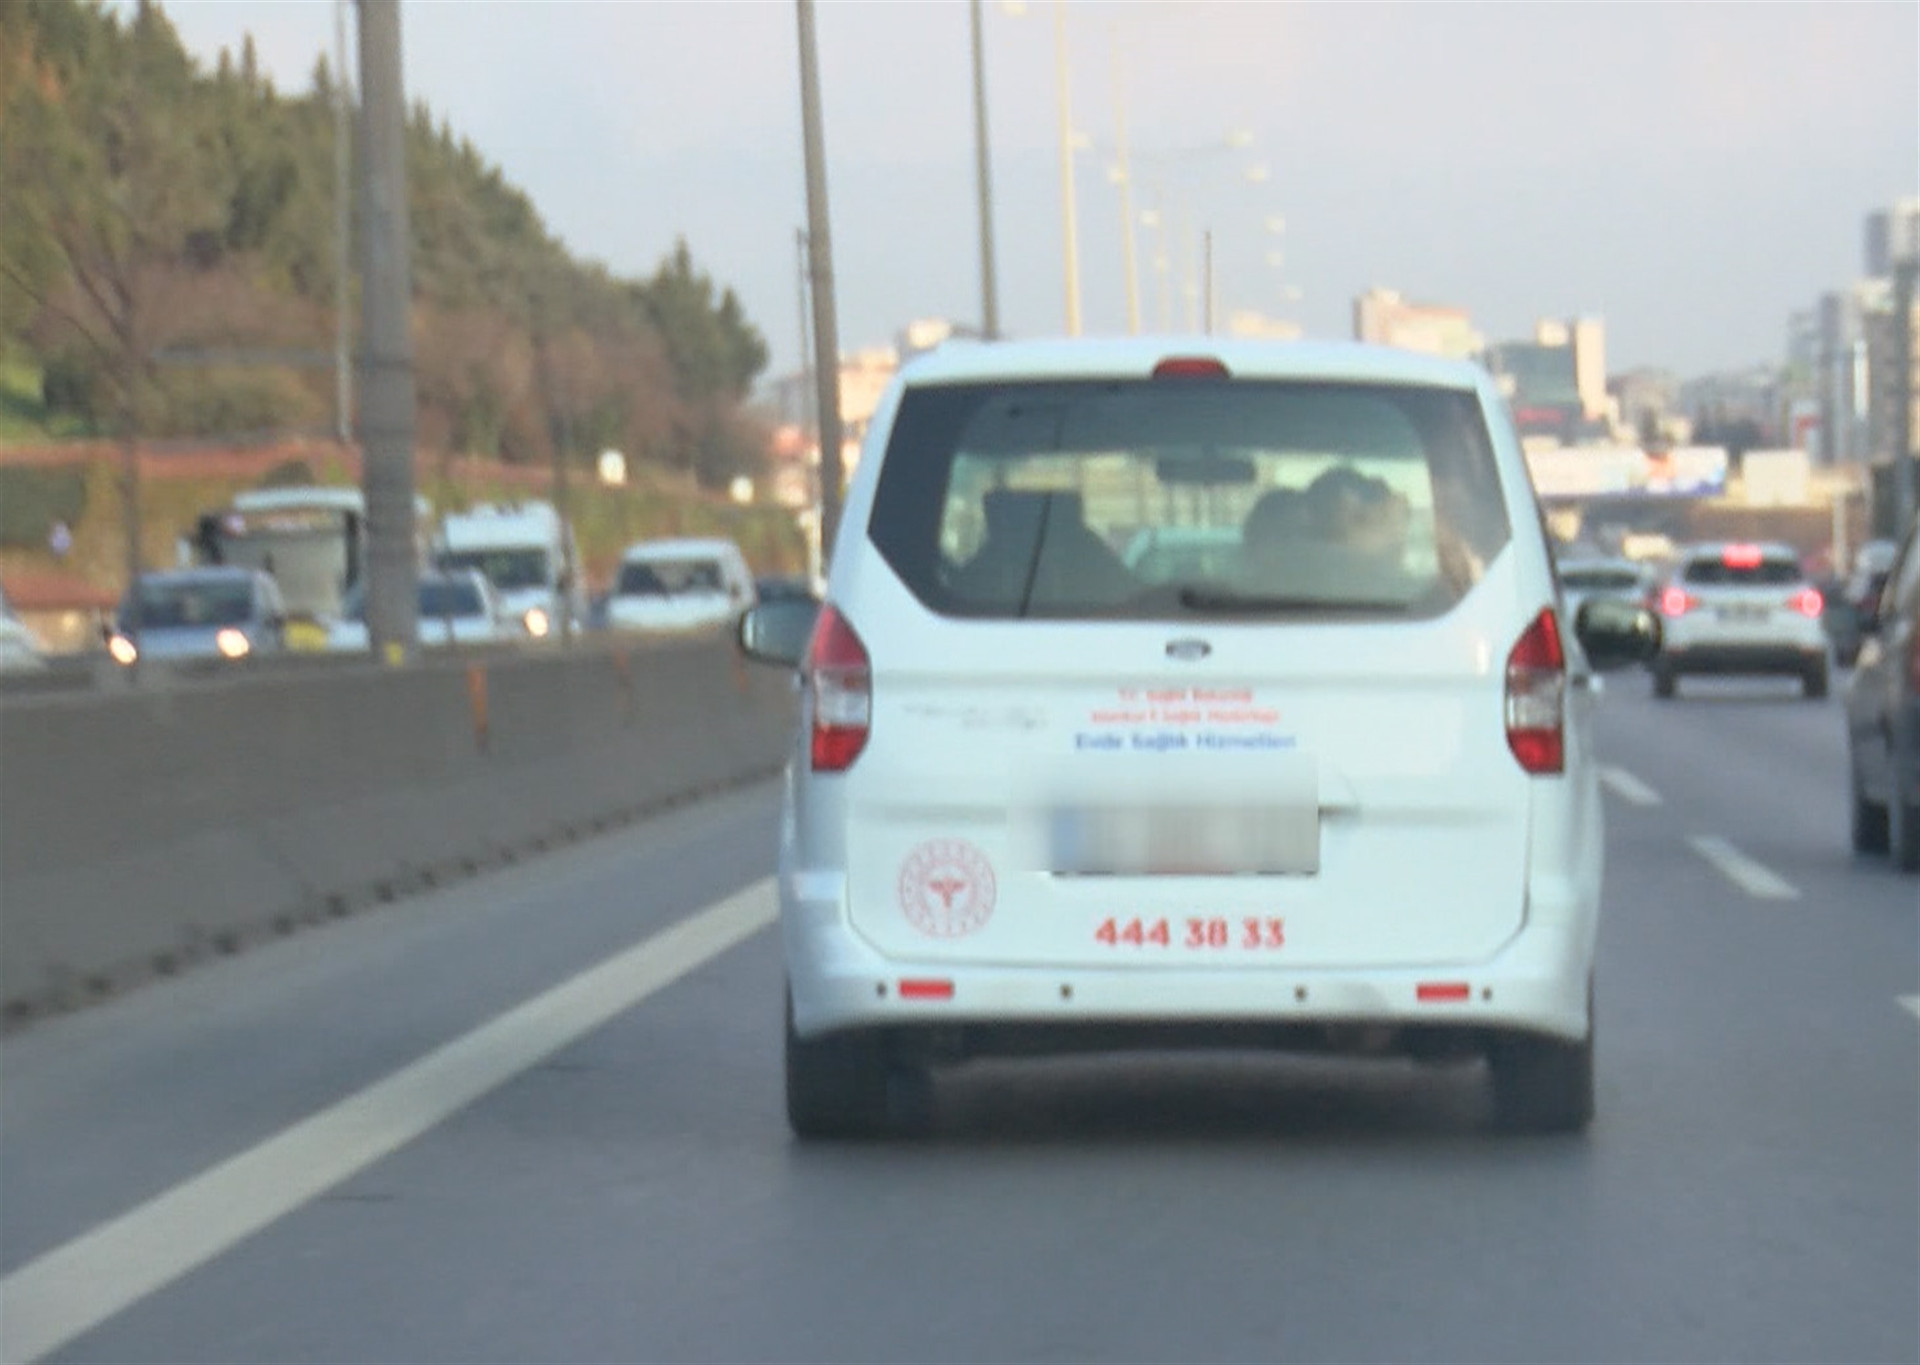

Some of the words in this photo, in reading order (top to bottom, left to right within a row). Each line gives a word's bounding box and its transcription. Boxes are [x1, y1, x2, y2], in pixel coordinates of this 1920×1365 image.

[1074, 731, 1122, 750] Evde
[1094, 916, 1171, 946] 444
[1241, 916, 1286, 949] 33
